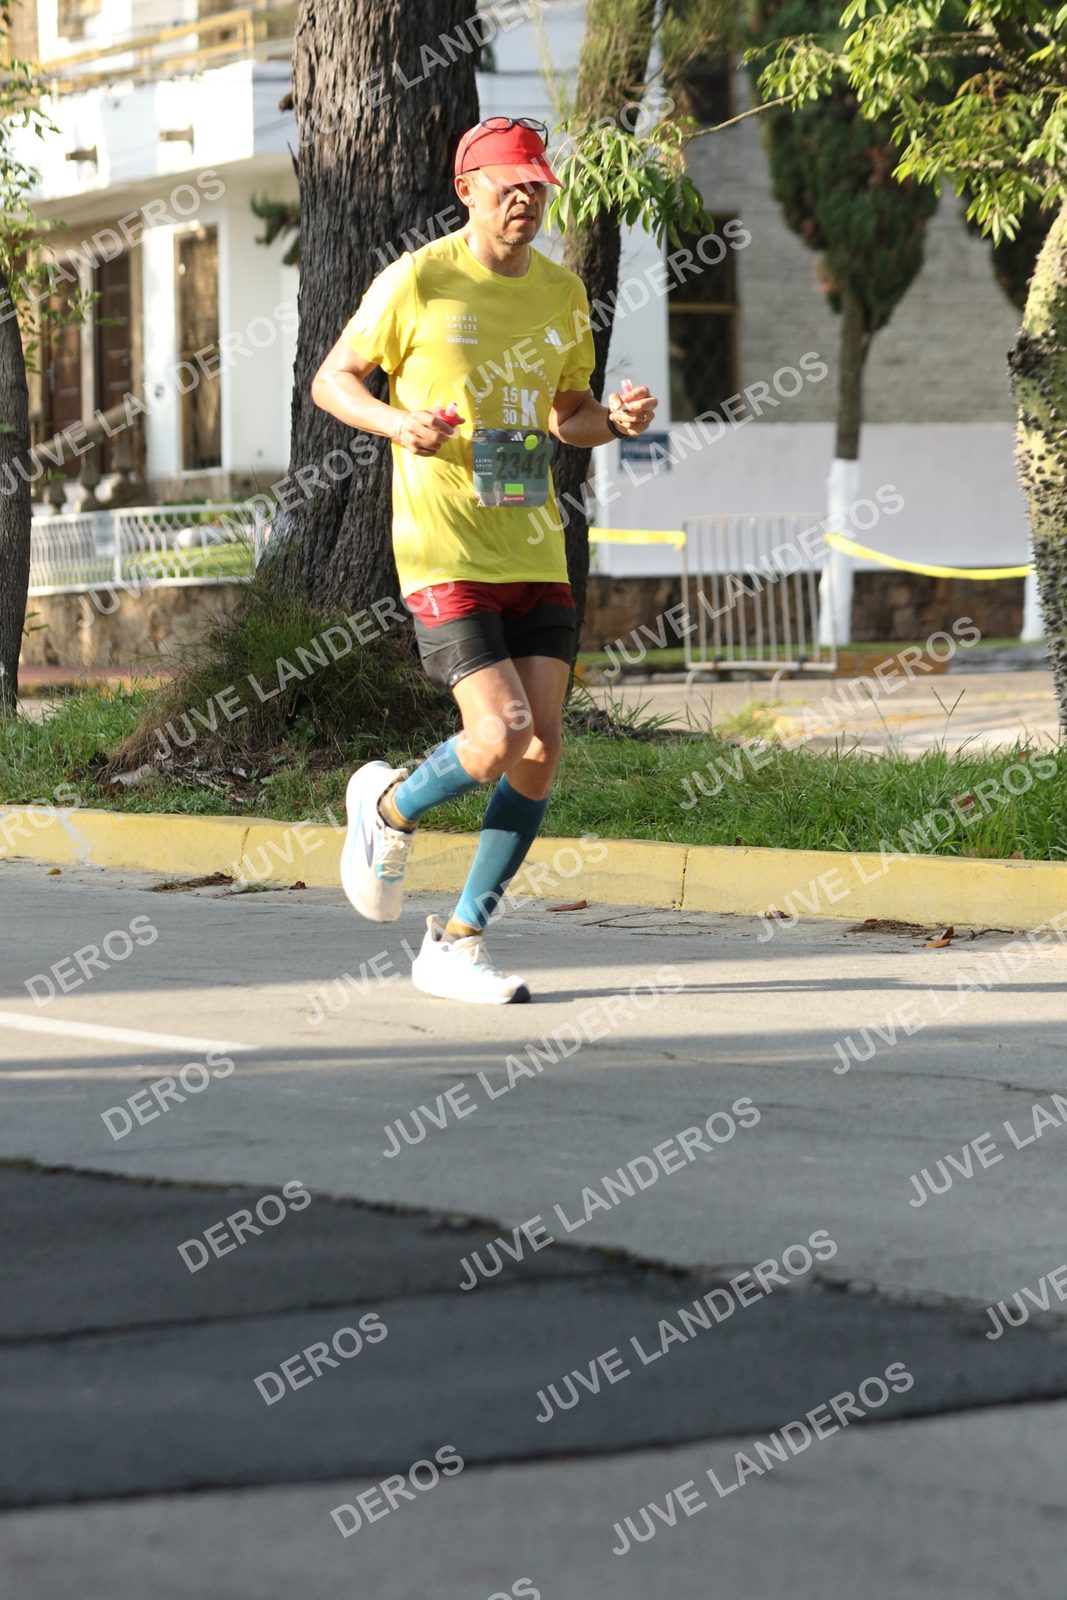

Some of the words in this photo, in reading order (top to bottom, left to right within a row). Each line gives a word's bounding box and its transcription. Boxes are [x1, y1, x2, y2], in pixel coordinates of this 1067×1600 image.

[503, 386, 518, 402] 15
[503, 408, 518, 425] 30
[521, 388, 539, 428] K
[496, 451, 547, 480] 2341
